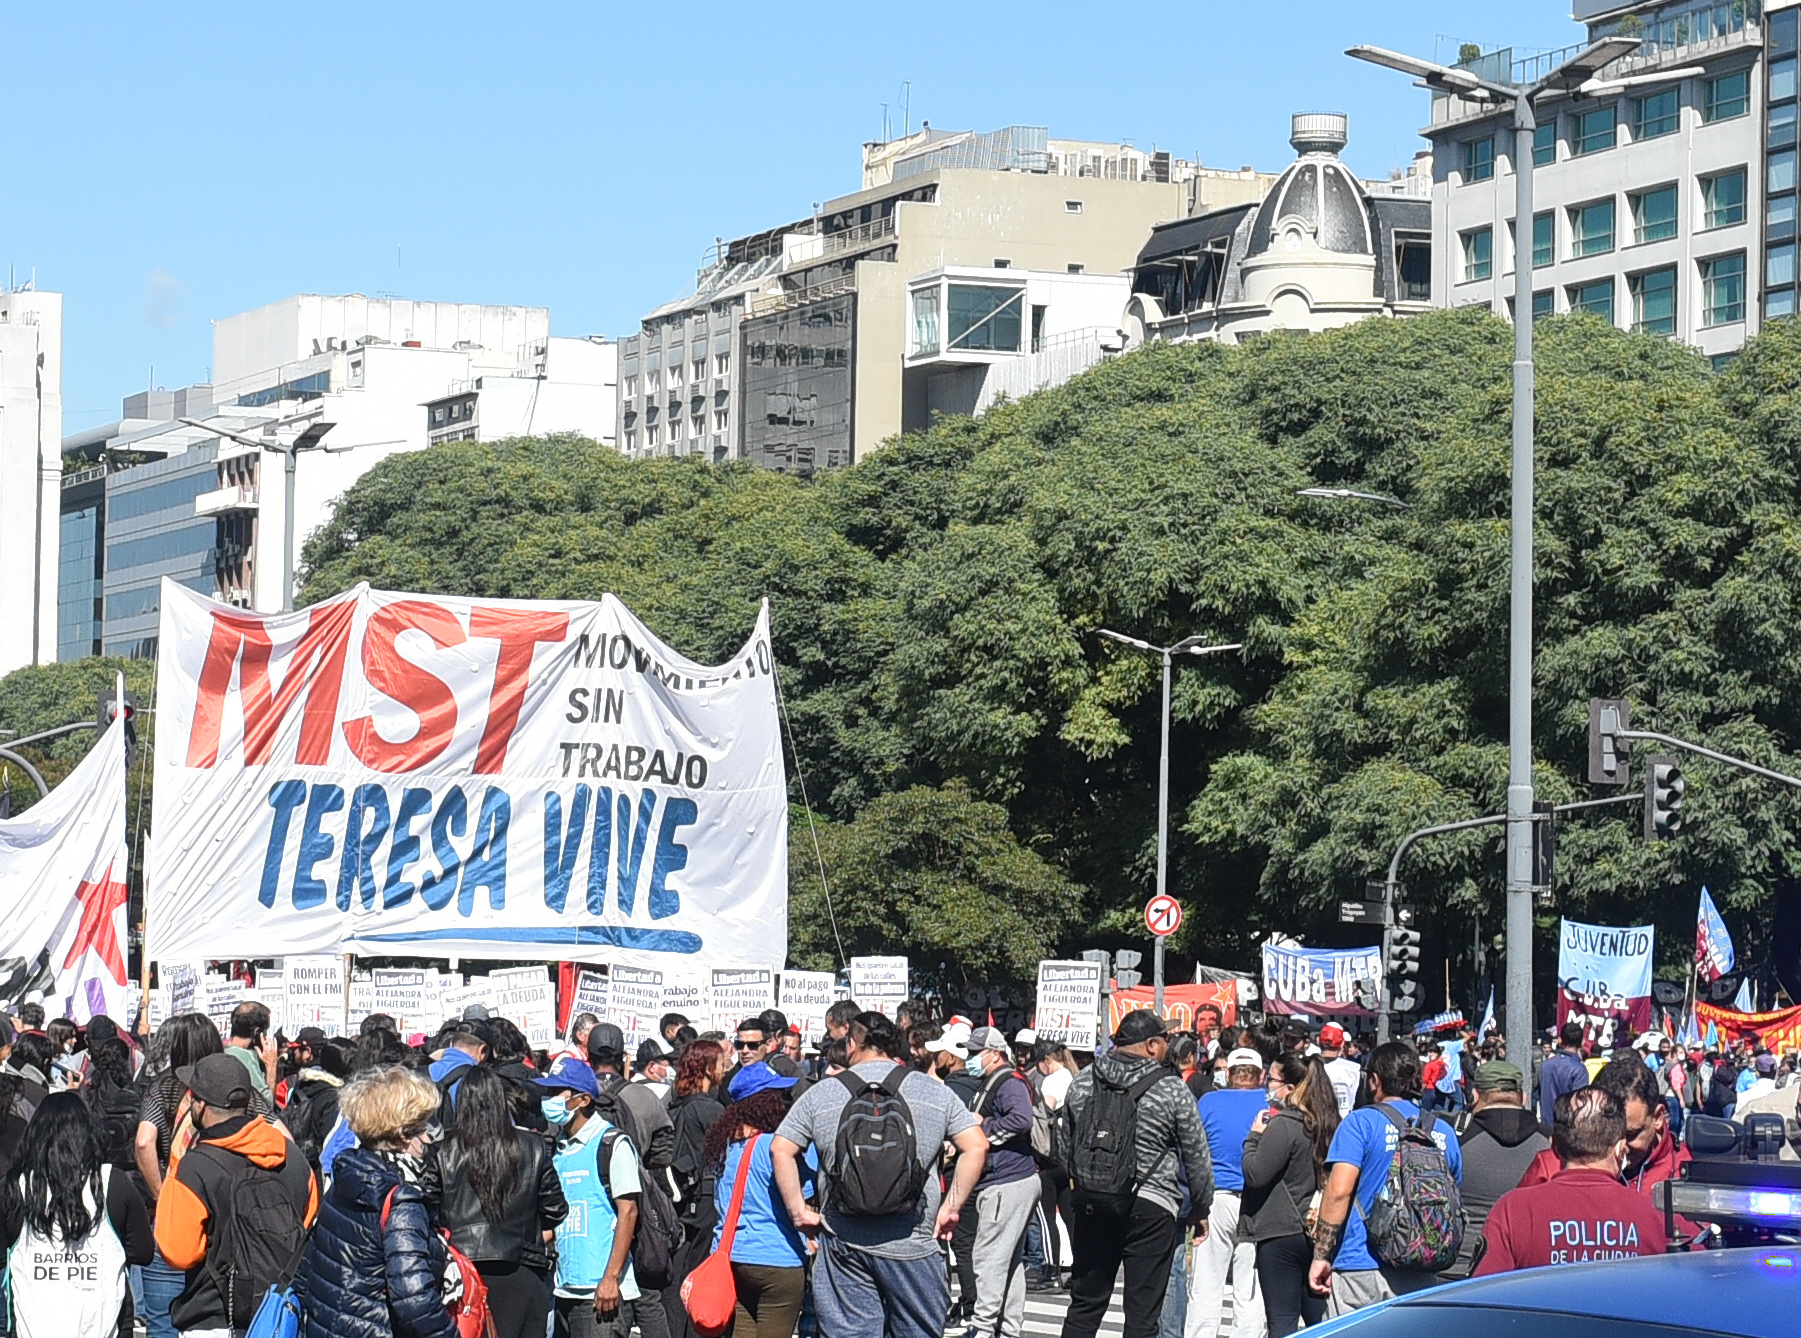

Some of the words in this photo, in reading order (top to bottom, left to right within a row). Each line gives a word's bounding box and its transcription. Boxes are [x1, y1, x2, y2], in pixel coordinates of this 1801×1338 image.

[185, 600, 570, 774] MST
[565, 687, 624, 725] SIN
[560, 742, 708, 790] TRABAJO
[257, 779, 511, 917] TERESA
[543, 782, 698, 920] VIVE
[1566, 924, 1648, 957] JUVENTUD
[294, 968, 337, 980] ROMPER
[613, 969, 654, 982] Libertad
[713, 970, 760, 985] Libertad
[1043, 967, 1088, 981] Libertad
[289, 983, 310, 994] CON
[313, 983, 322, 994] EL
[324, 983, 342, 995] FMI
[612, 983, 659, 999] ALEJANDRA
[663, 985, 698, 998] rabajo
[785, 978, 797, 989] NO
[798, 978, 806, 989] al
[808, 979, 829, 992] pago
[1043, 984, 1094, 993] ALEJANDRA
[511, 988, 546, 1004] DEUDA
[713, 989, 769, 998] ALEJANDRA
[783, 992, 793, 1004] de
[794, 992, 802, 1004] la
[804, 993, 831, 1004] deuda
[662, 998, 700, 1008] enuino
[1038, 1007, 1071, 1028] MST
[1039, 1029, 1068, 1042] TERESA
[1071, 1030, 1091, 1044] VIVE
[1549, 1220, 1638, 1247] POLICIA
[34, 1253, 98, 1263] BARRIOS
[1550, 1250, 1568, 1264] DE
[1573, 1250, 1589, 1262] LA
[34, 1266, 60, 1280] DE
[67, 1266, 98, 1280] PIE
